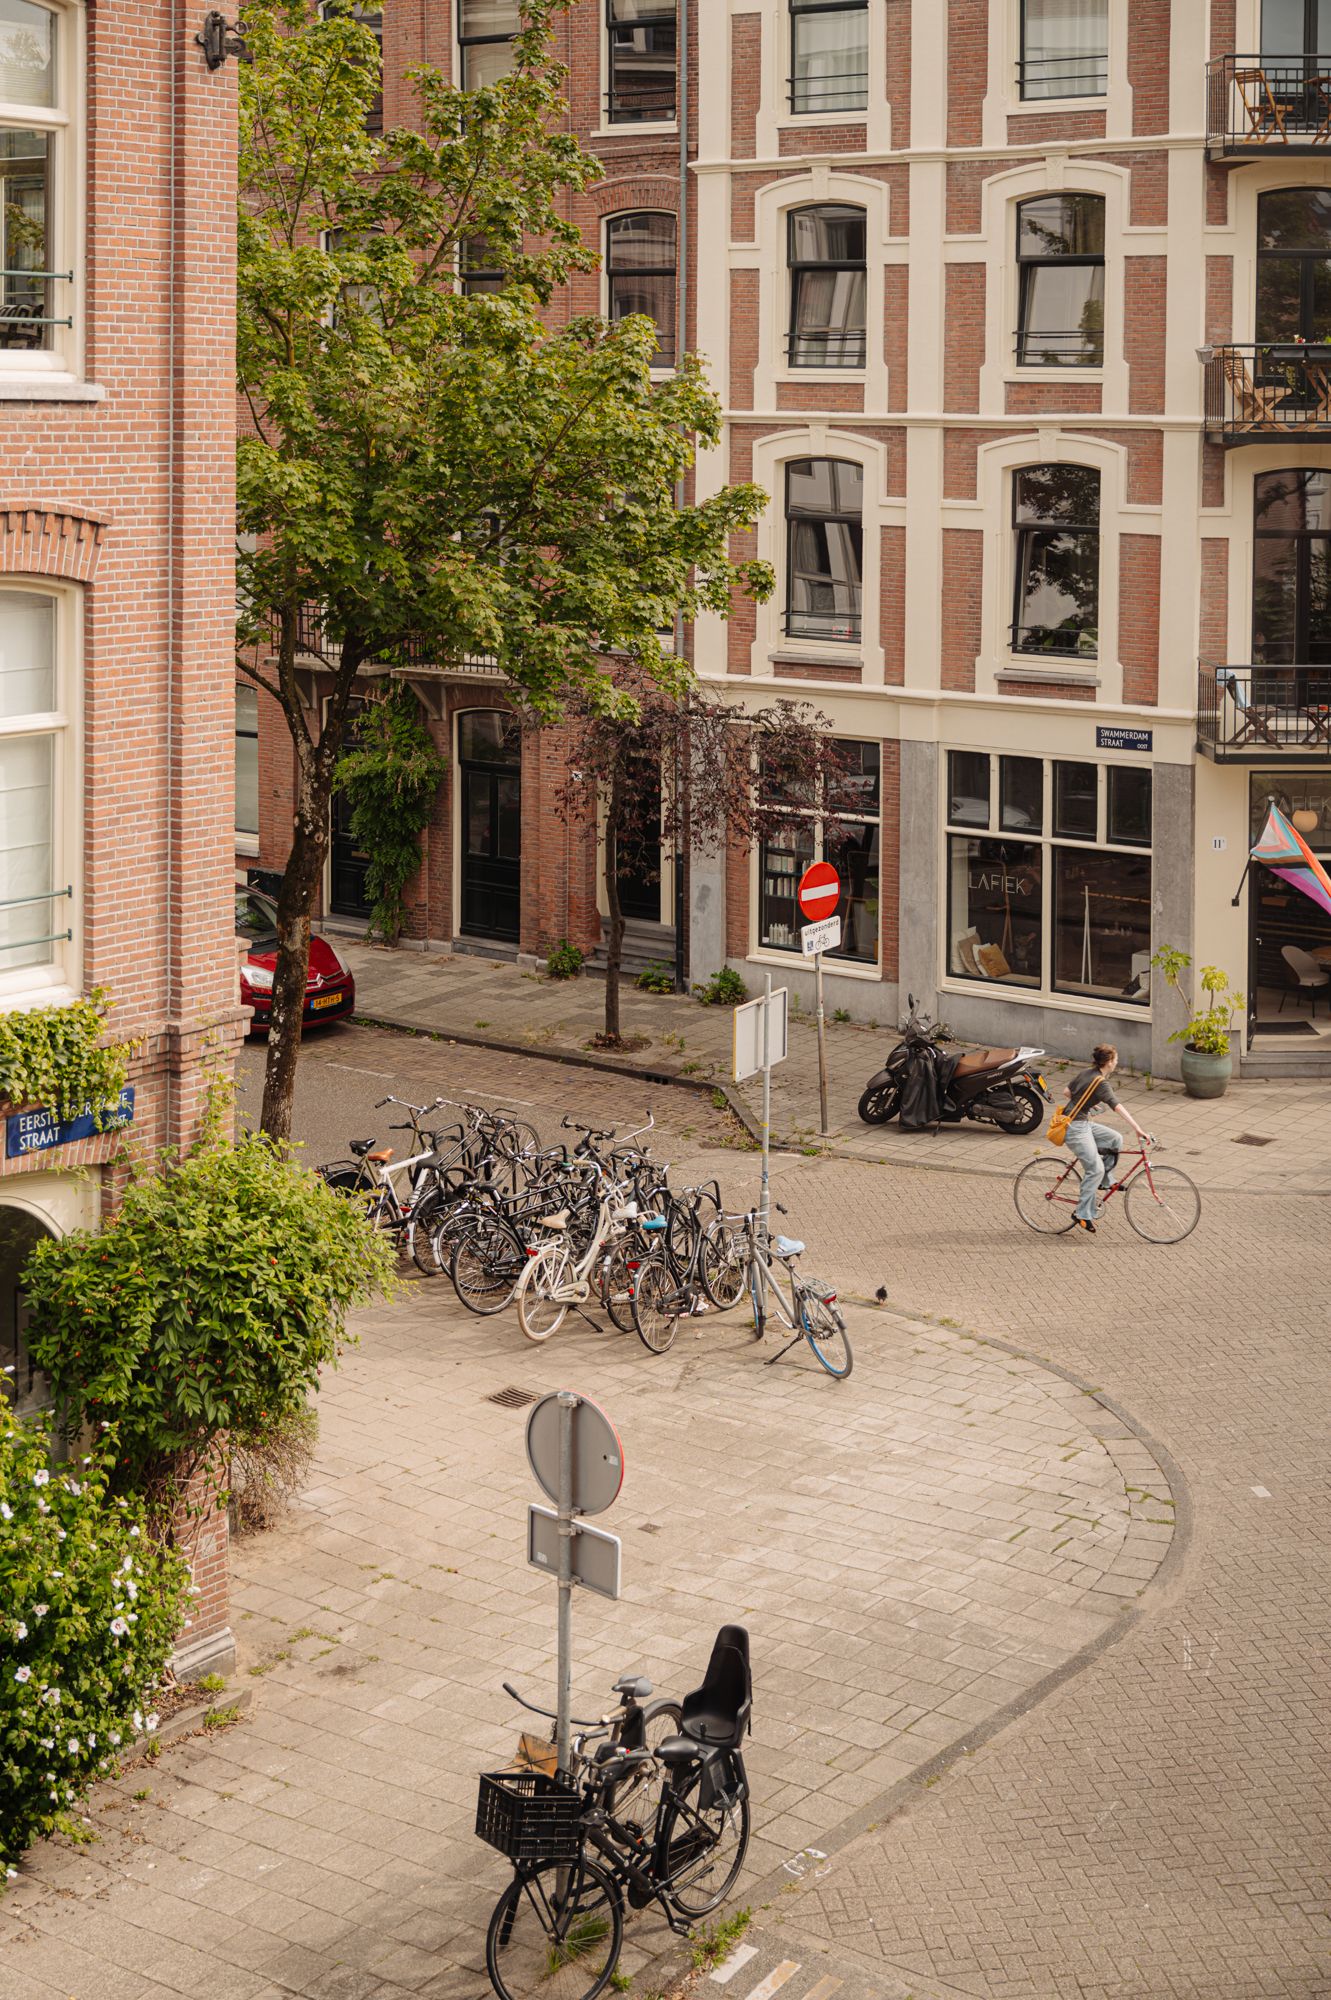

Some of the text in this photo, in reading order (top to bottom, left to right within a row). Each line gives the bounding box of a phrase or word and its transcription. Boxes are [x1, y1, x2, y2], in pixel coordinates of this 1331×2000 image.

[1100, 729, 1149, 741] SWAMMERDAM
[1100, 738, 1124, 748] STRAAT
[968, 872, 1026, 896] LAFIEK
[804, 920, 839, 936] uitgezonderd
[20, 1127, 60, 1150] STRAAT
